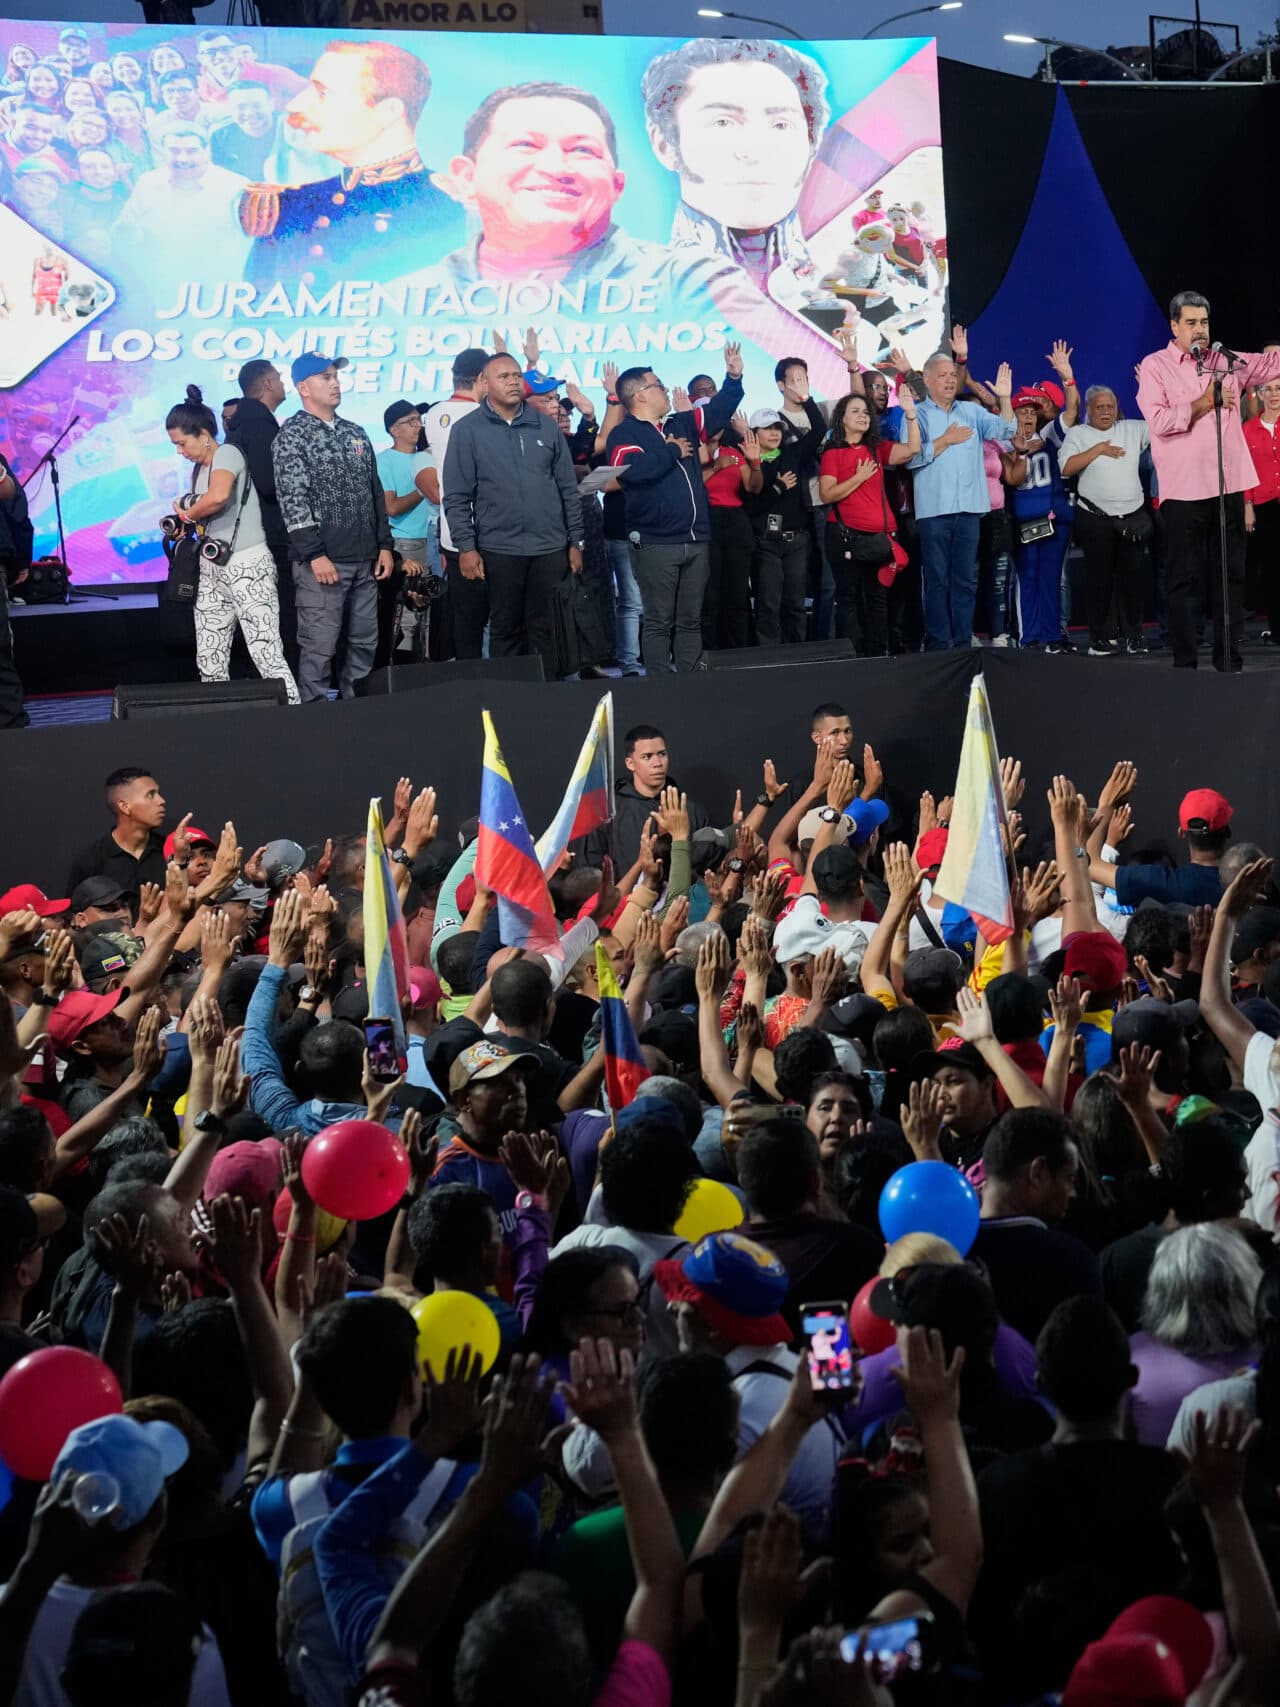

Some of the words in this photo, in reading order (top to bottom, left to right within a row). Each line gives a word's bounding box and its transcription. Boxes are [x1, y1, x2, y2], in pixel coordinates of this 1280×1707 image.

[351, 0, 449, 23] AMOR
[456, 3, 478, 22] A
[482, 2, 517, 22] LO
[156, 271, 587, 319] JURAMENTACIÓN
[597, 278, 660, 314] DE
[86, 329, 182, 362] LOS
[191, 319, 397, 360] COMITÉS
[405, 320, 729, 356] BOLIVARIANOS
